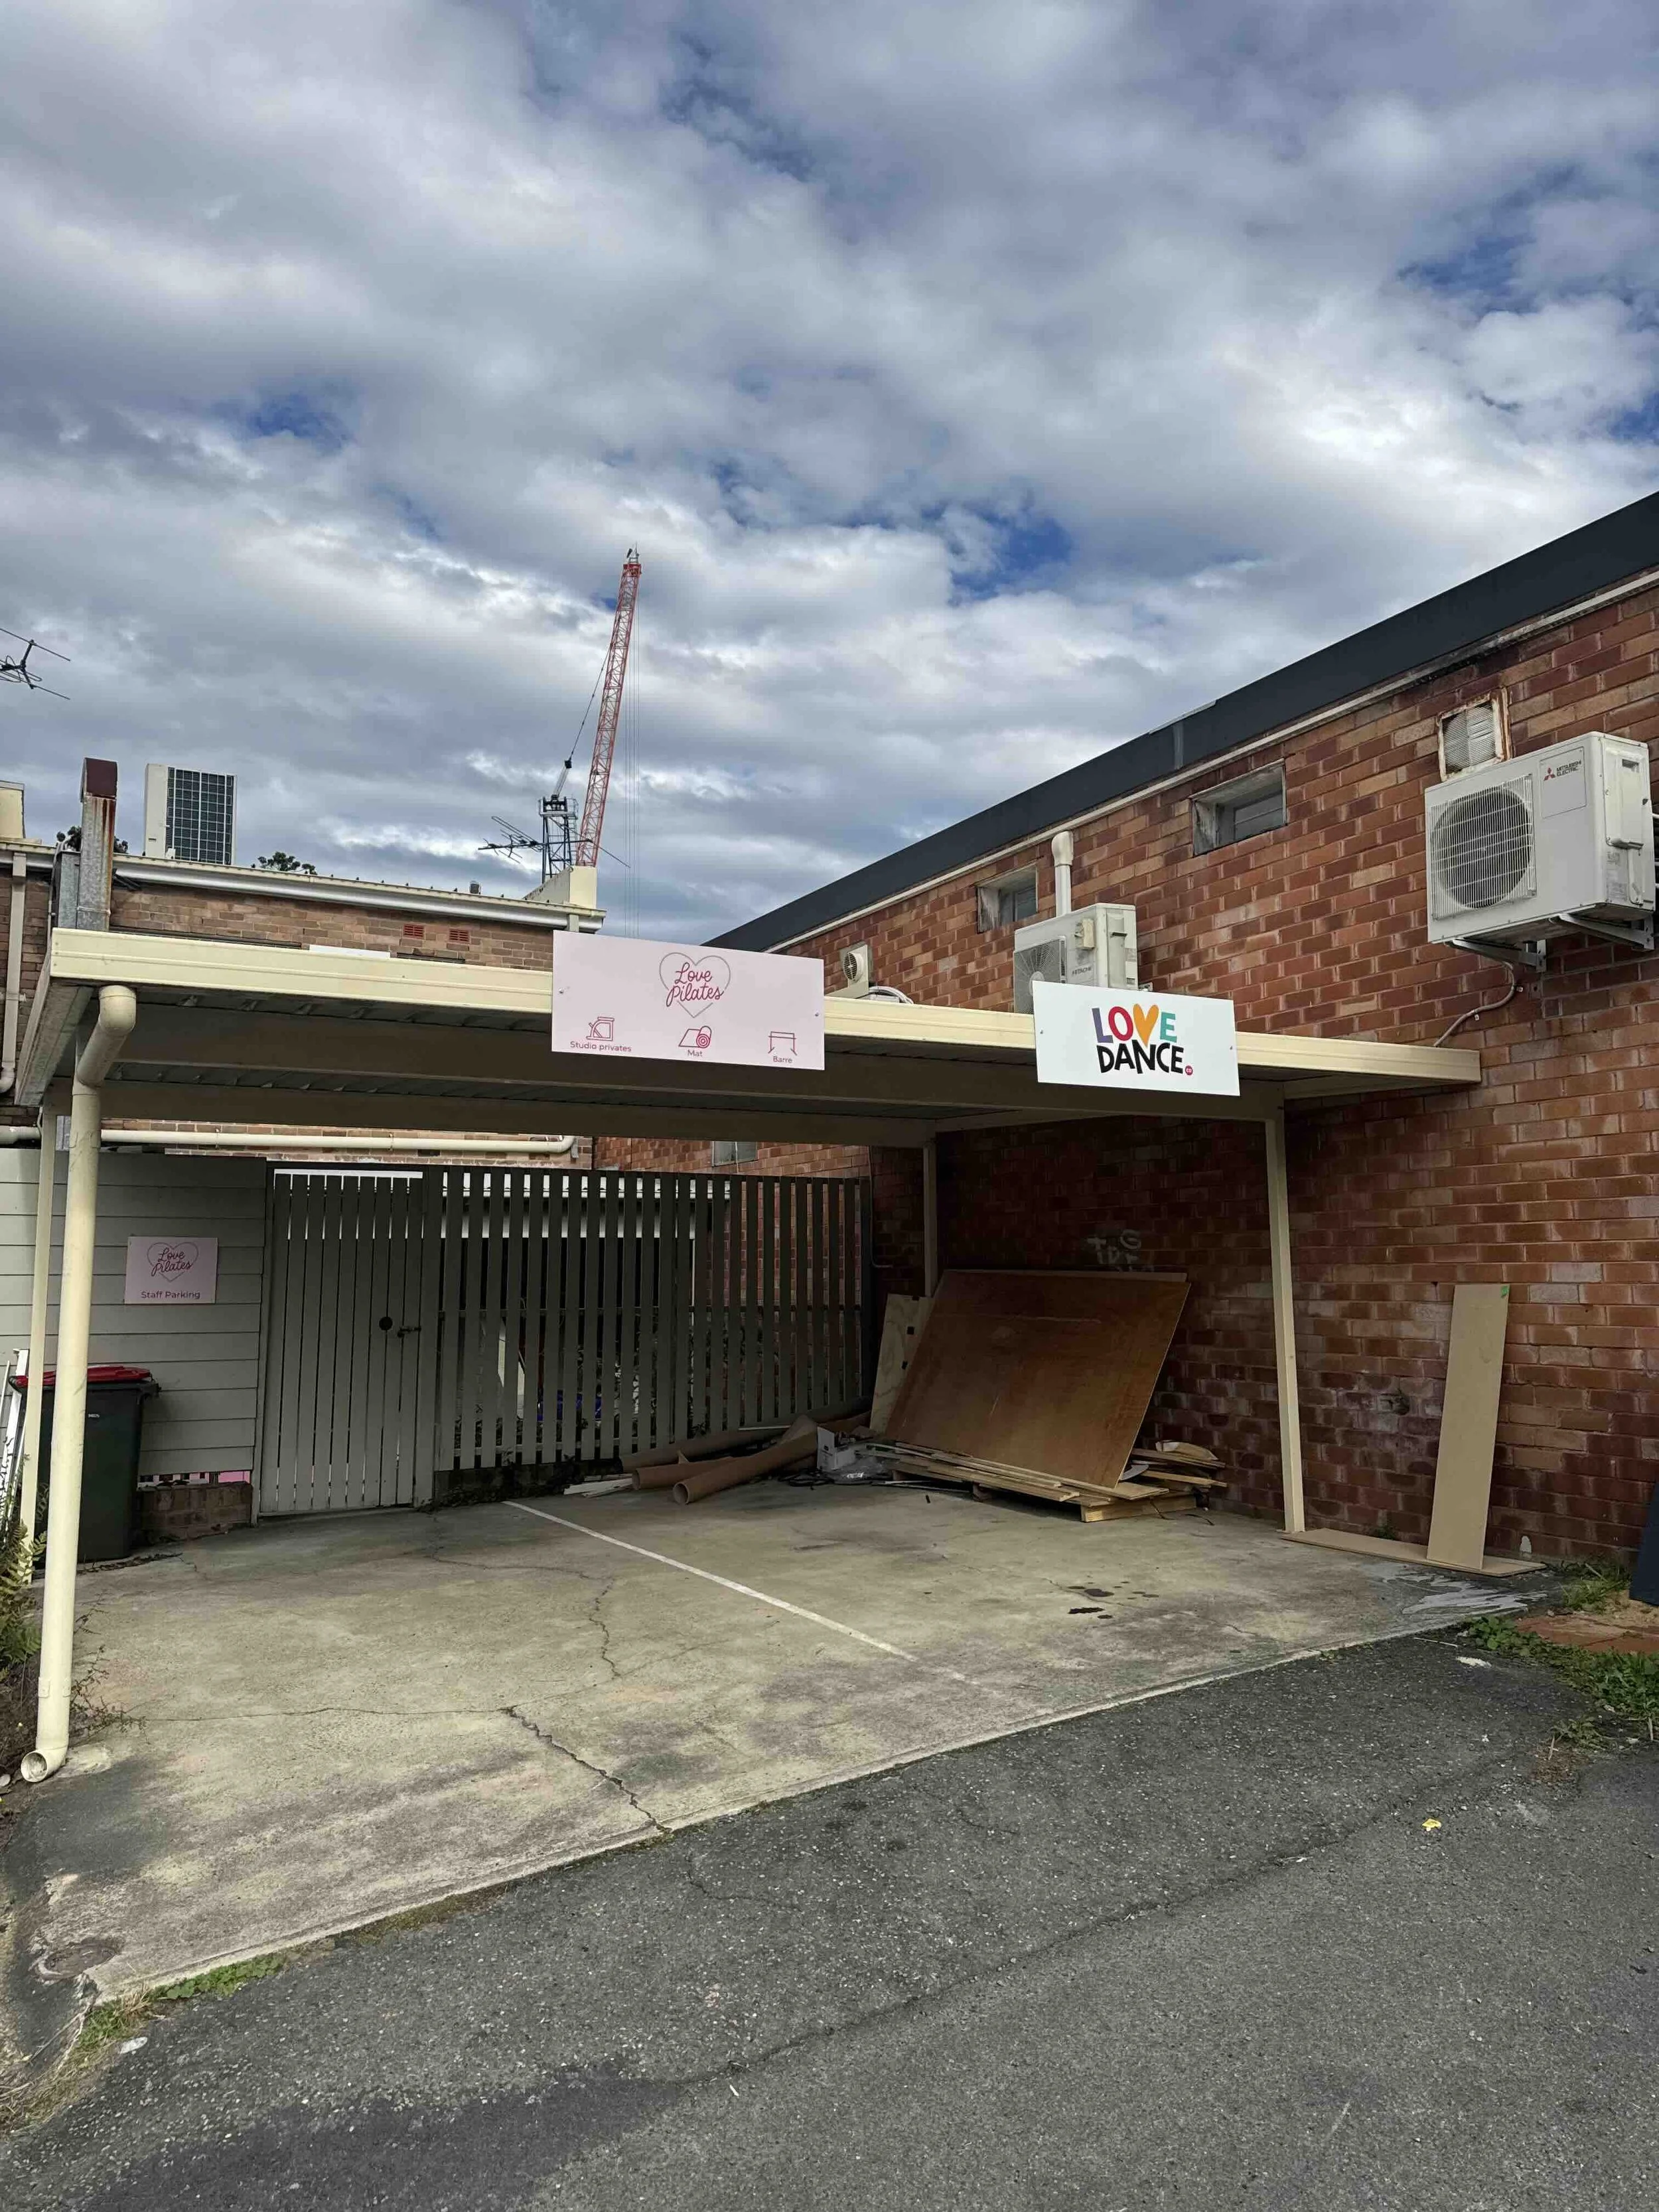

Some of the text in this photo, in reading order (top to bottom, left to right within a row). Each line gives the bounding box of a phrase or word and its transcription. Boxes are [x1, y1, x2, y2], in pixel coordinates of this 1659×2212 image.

[675, 962, 712, 984] Love
[1092, 1003, 1177, 1048] LOVE
[570, 1041, 632, 1053] Studio privates
[157, 1247, 186, 1262] Love
